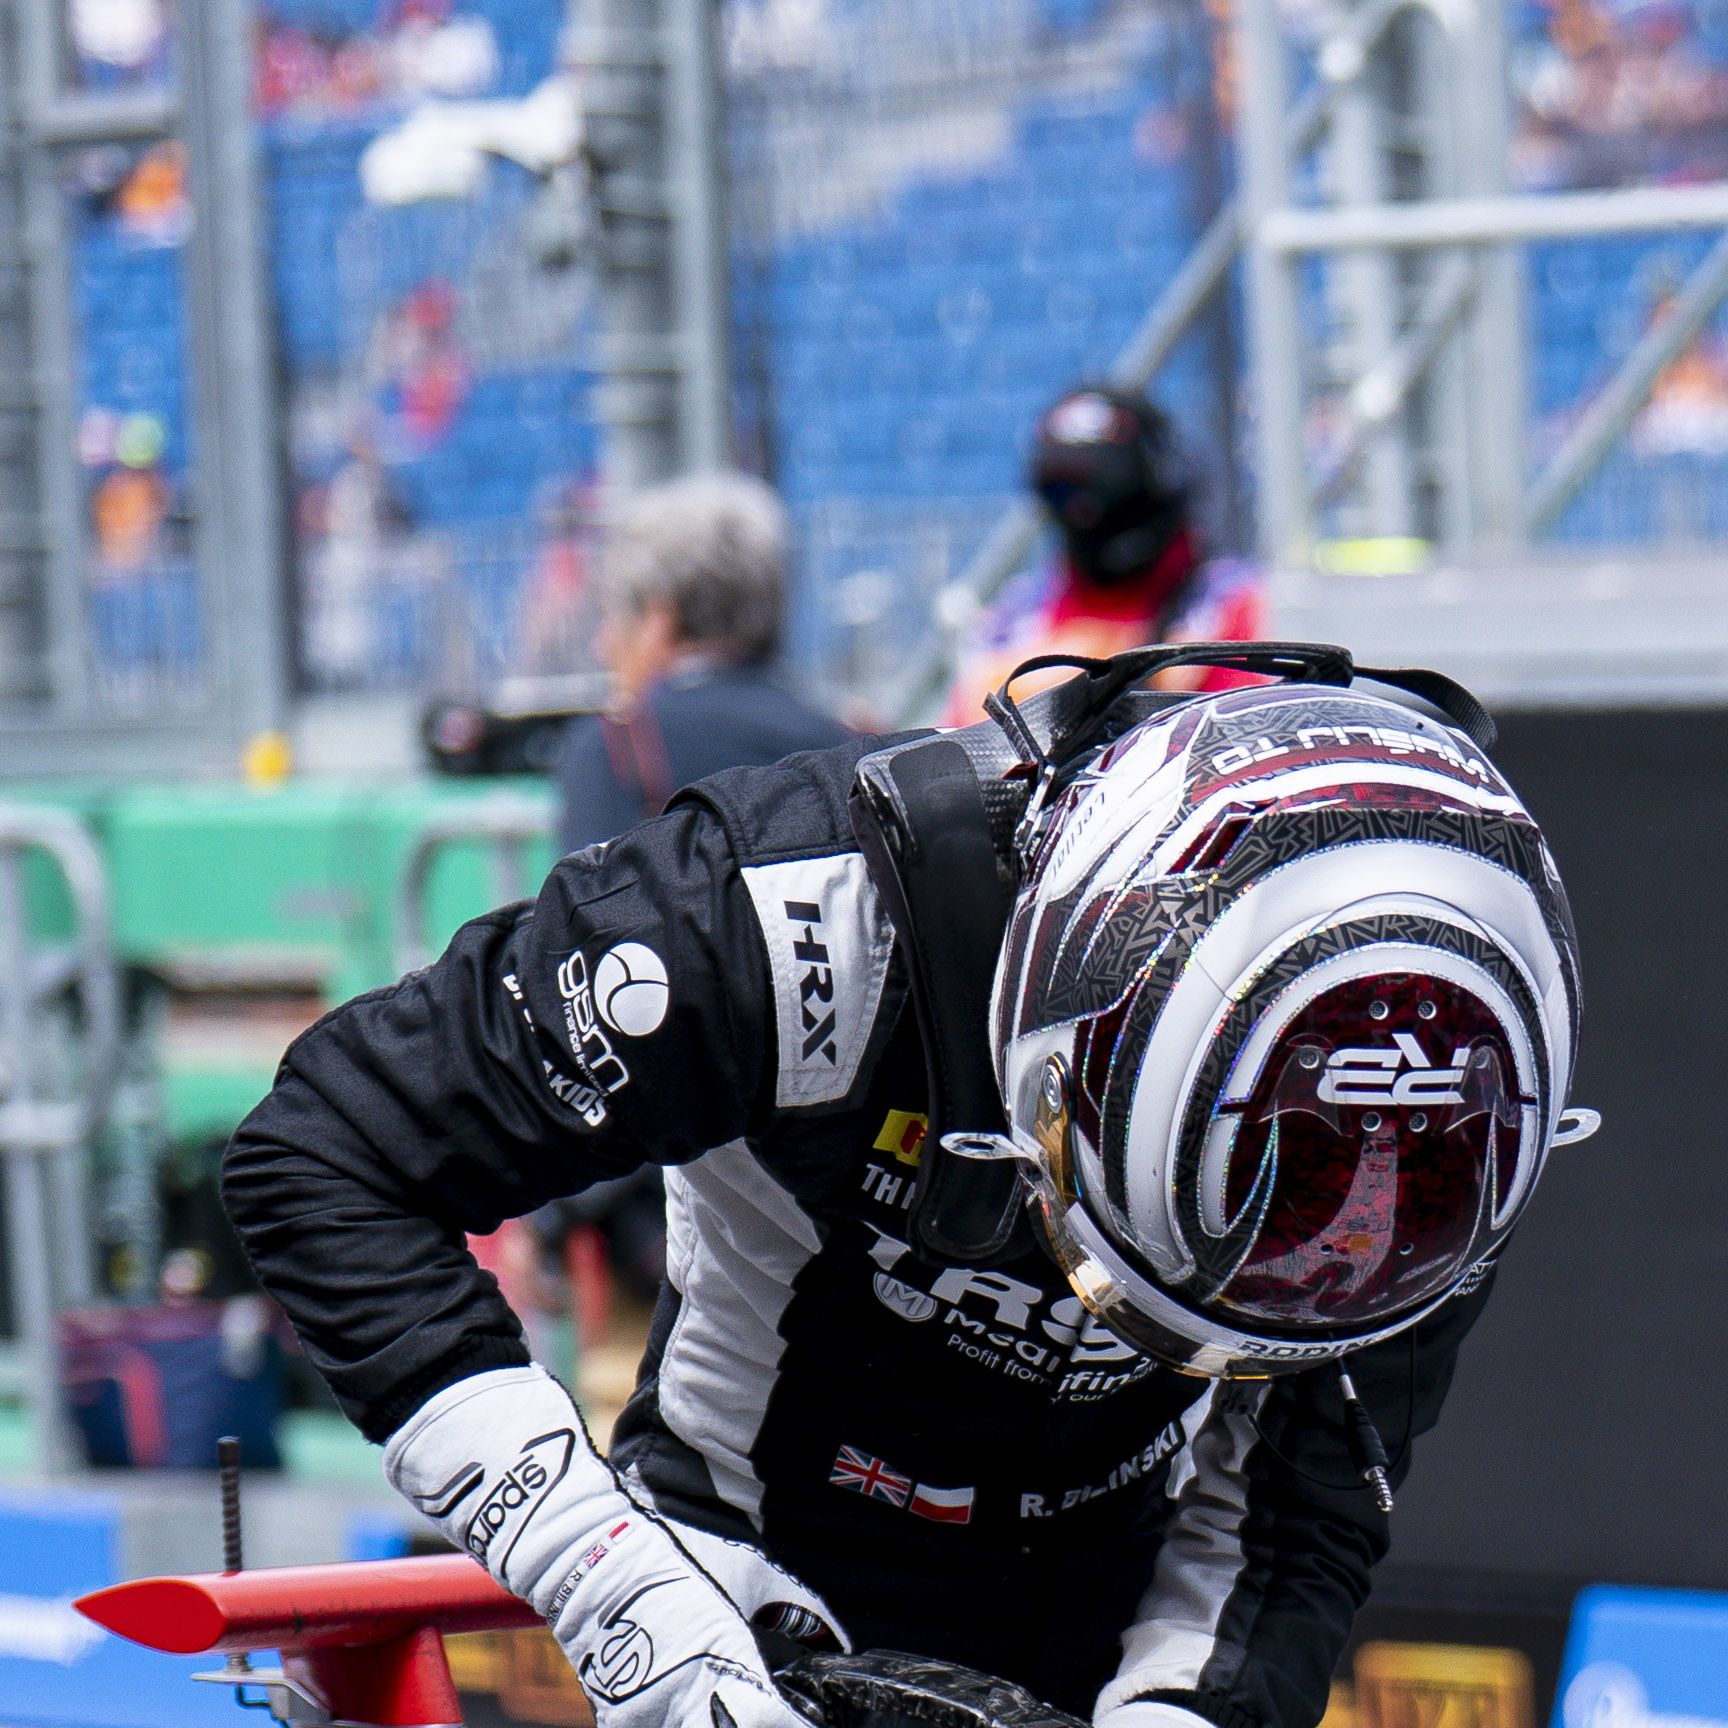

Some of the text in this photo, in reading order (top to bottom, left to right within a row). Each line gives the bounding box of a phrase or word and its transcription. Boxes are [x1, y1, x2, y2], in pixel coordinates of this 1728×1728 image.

[557, 950, 630, 1093] gsm
[562, 1001, 582, 1054] finance
[783, 900, 838, 1067] HRX
[947, 1333, 1000, 1370] Profit
[468, 1462, 547, 1561] sparc
